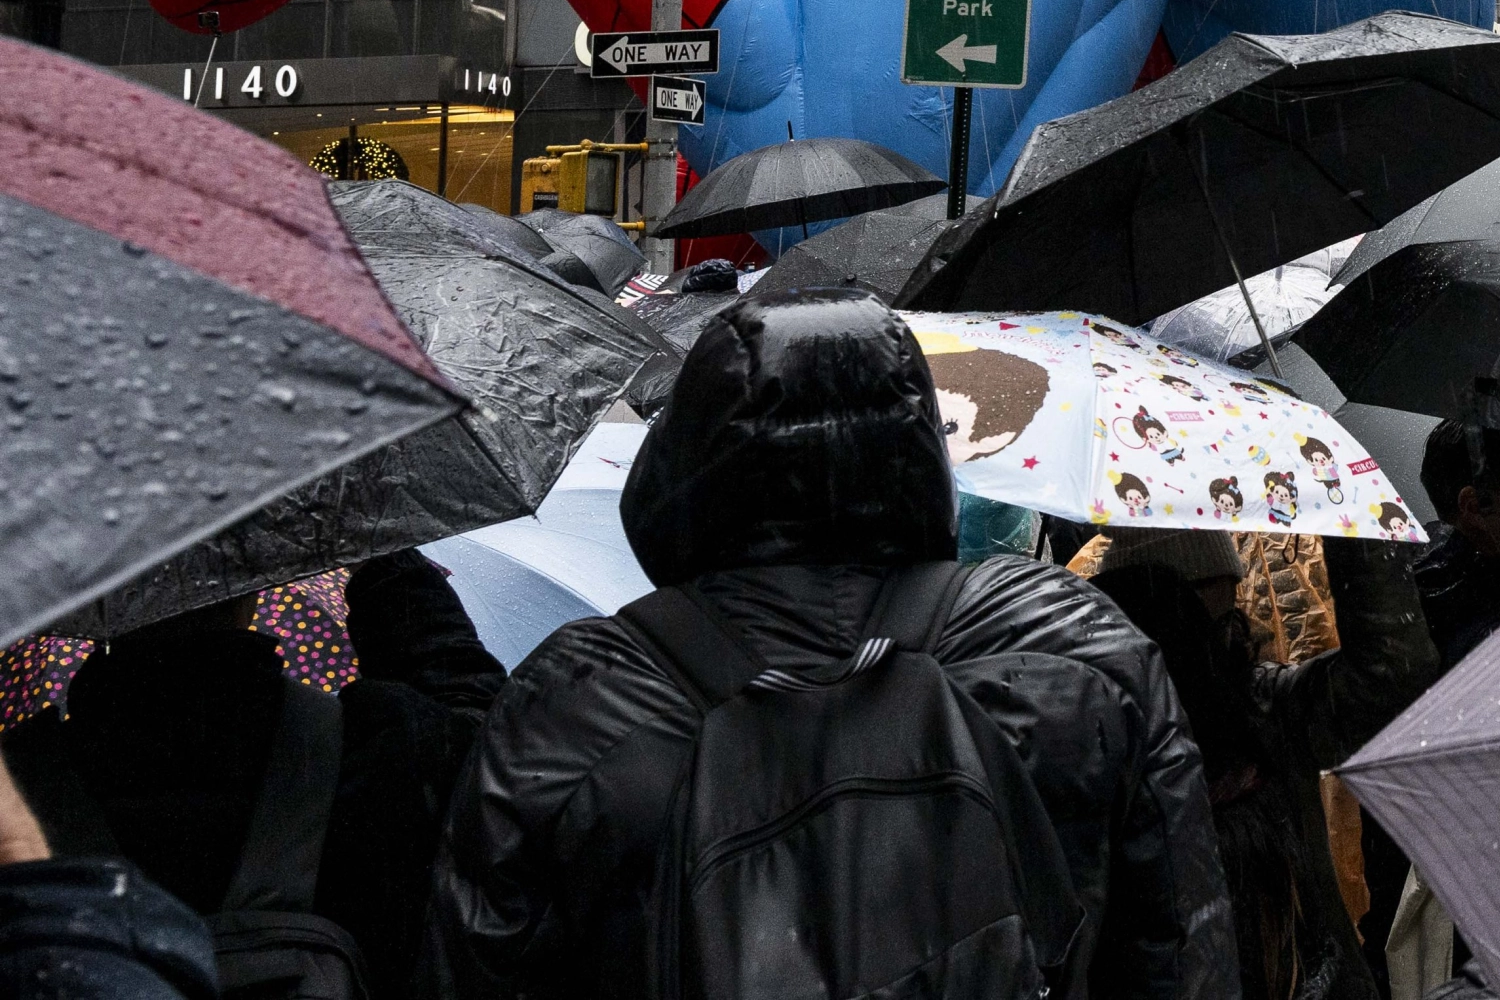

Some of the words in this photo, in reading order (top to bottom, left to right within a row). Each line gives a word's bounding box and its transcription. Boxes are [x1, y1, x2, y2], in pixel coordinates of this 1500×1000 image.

[612, 45, 647, 63] ONE
[664, 43, 703, 61] WAY
[183, 64, 298, 101] 1140
[464, 68, 512, 97] 1140
[660, 89, 678, 108] ONE
[685, 93, 699, 111] WAY
